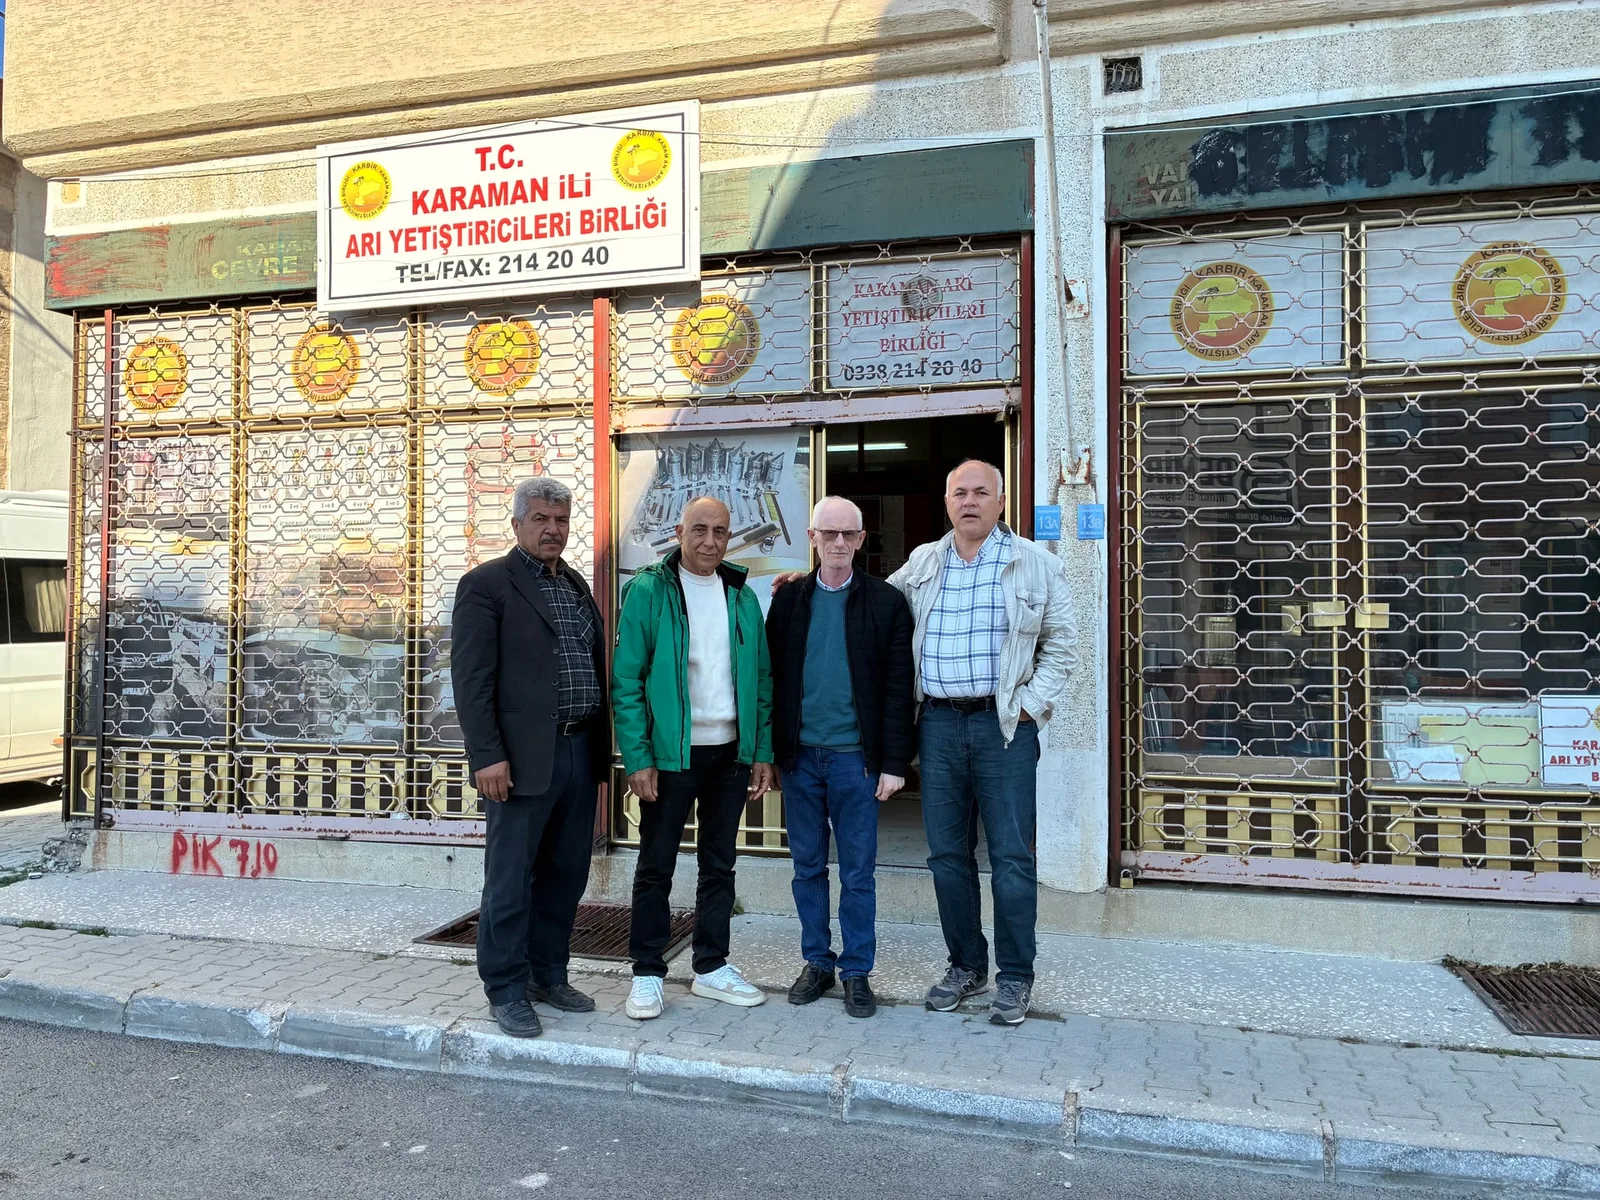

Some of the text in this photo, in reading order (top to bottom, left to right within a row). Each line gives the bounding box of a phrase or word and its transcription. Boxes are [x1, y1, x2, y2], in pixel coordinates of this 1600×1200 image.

[475, 144, 524, 172] T.C.
[412, 177, 549, 215] KARAMAN
[345, 231, 381, 258] ARI
[396, 246, 609, 283] TEL/FAX: 214 20 40
[1196, 264, 1247, 280] KARBİR
[854, 275, 974, 299] KARAMAN ARI
[1245, 330, 1261, 347] ARI
[844, 358, 982, 382] 0338 214 20 40
[1038, 515, 1059, 530] 13A
[1572, 740, 1600, 751] KAR
[1550, 755, 1571, 765] ARI
